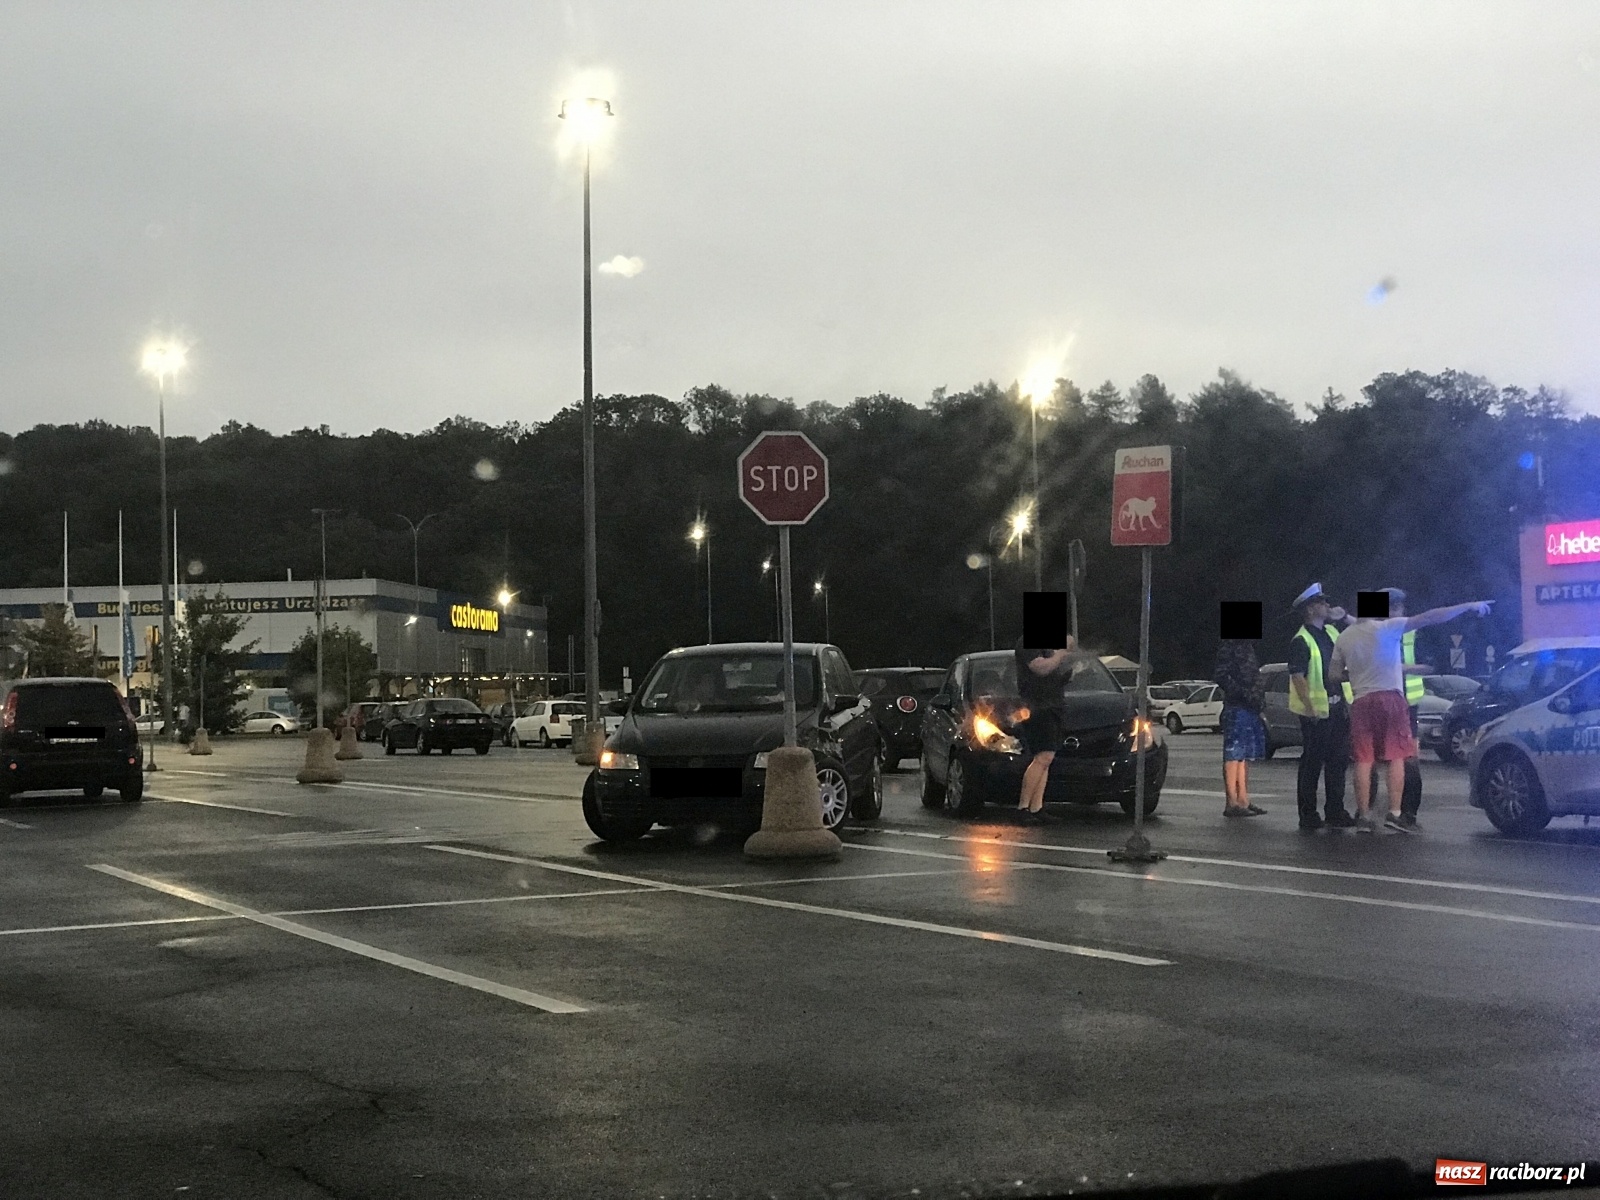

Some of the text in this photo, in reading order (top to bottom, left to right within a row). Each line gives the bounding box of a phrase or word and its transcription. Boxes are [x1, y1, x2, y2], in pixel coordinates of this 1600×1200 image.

[1122, 456, 1164, 469] Auchan
[750, 465, 818, 492] STOP
[1560, 531, 1600, 555] hebe
[451, 601, 498, 632] castorama
